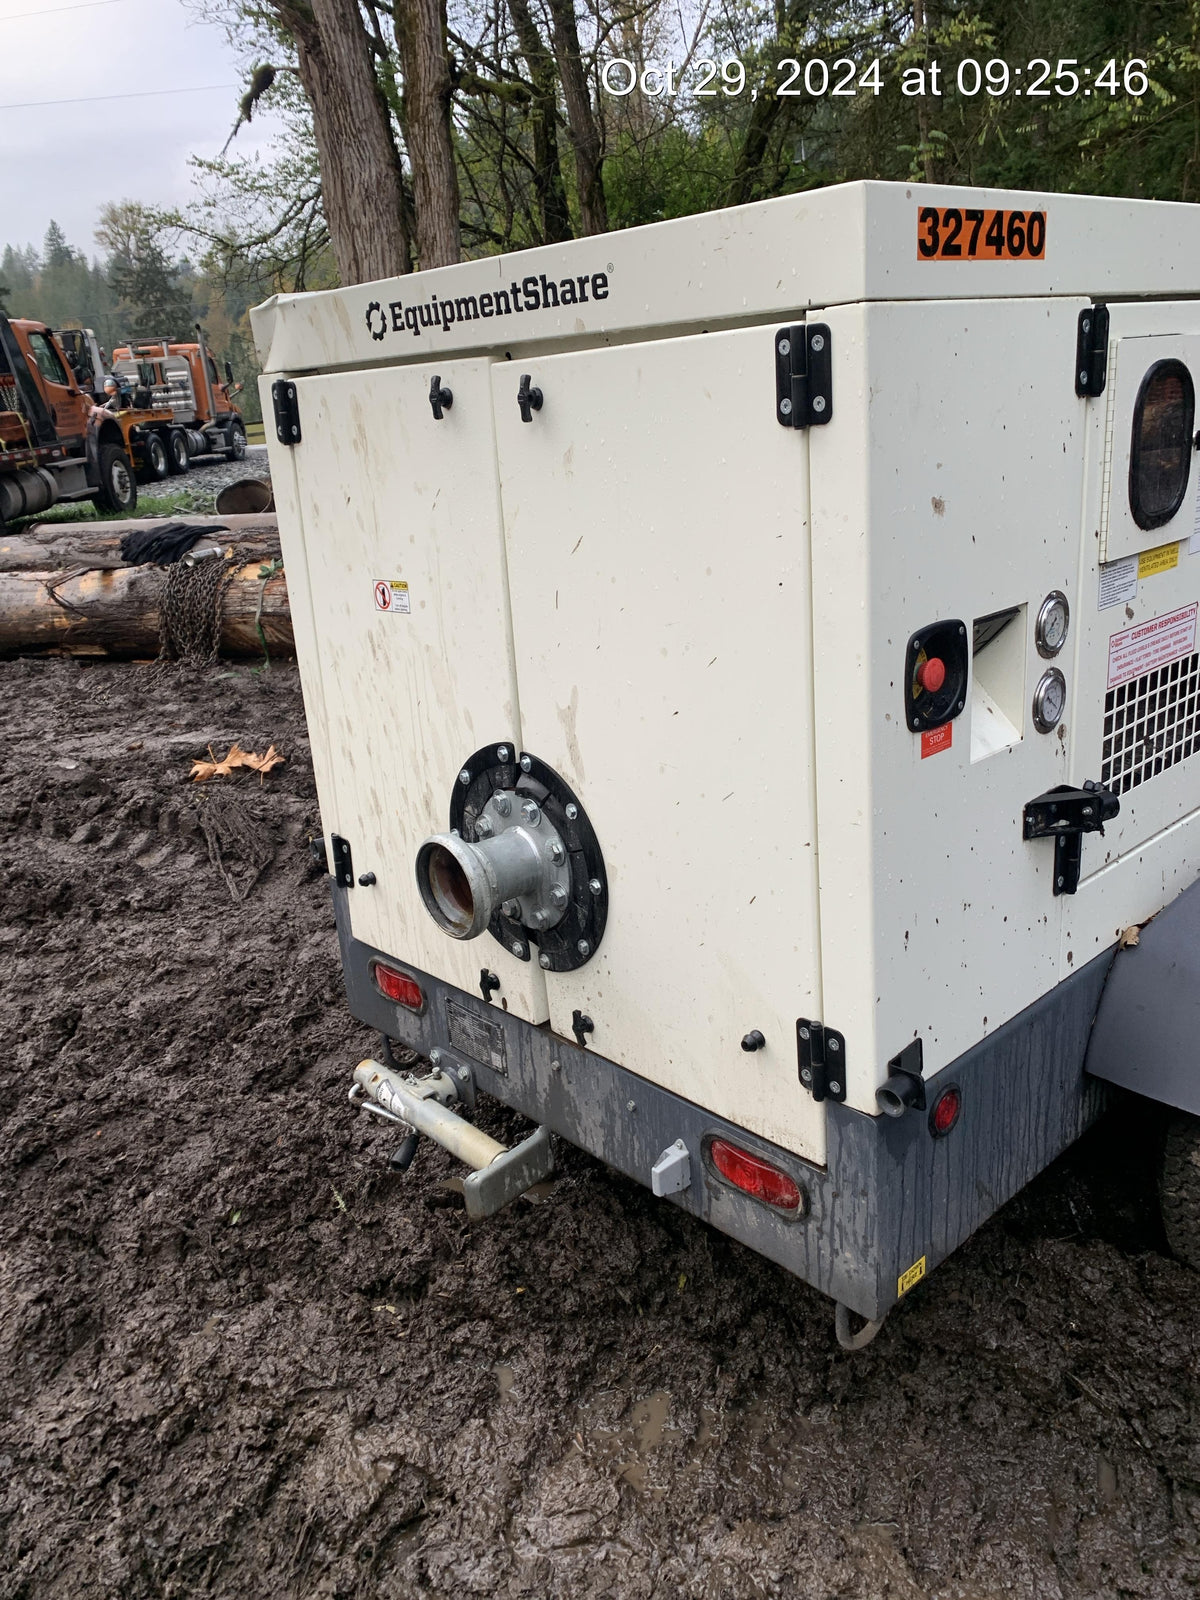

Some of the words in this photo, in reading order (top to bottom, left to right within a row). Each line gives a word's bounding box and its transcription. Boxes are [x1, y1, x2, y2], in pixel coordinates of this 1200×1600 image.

[919, 208, 1045, 258] 327460
[389, 272, 609, 337] EquipmentShare
[1131, 623, 1158, 640] CUSTOMER
[1158, 608, 1195, 628] RESPONSIBILITY
[925, 725, 948, 738] EMERGENCY
[929, 732, 945, 745] STOP
